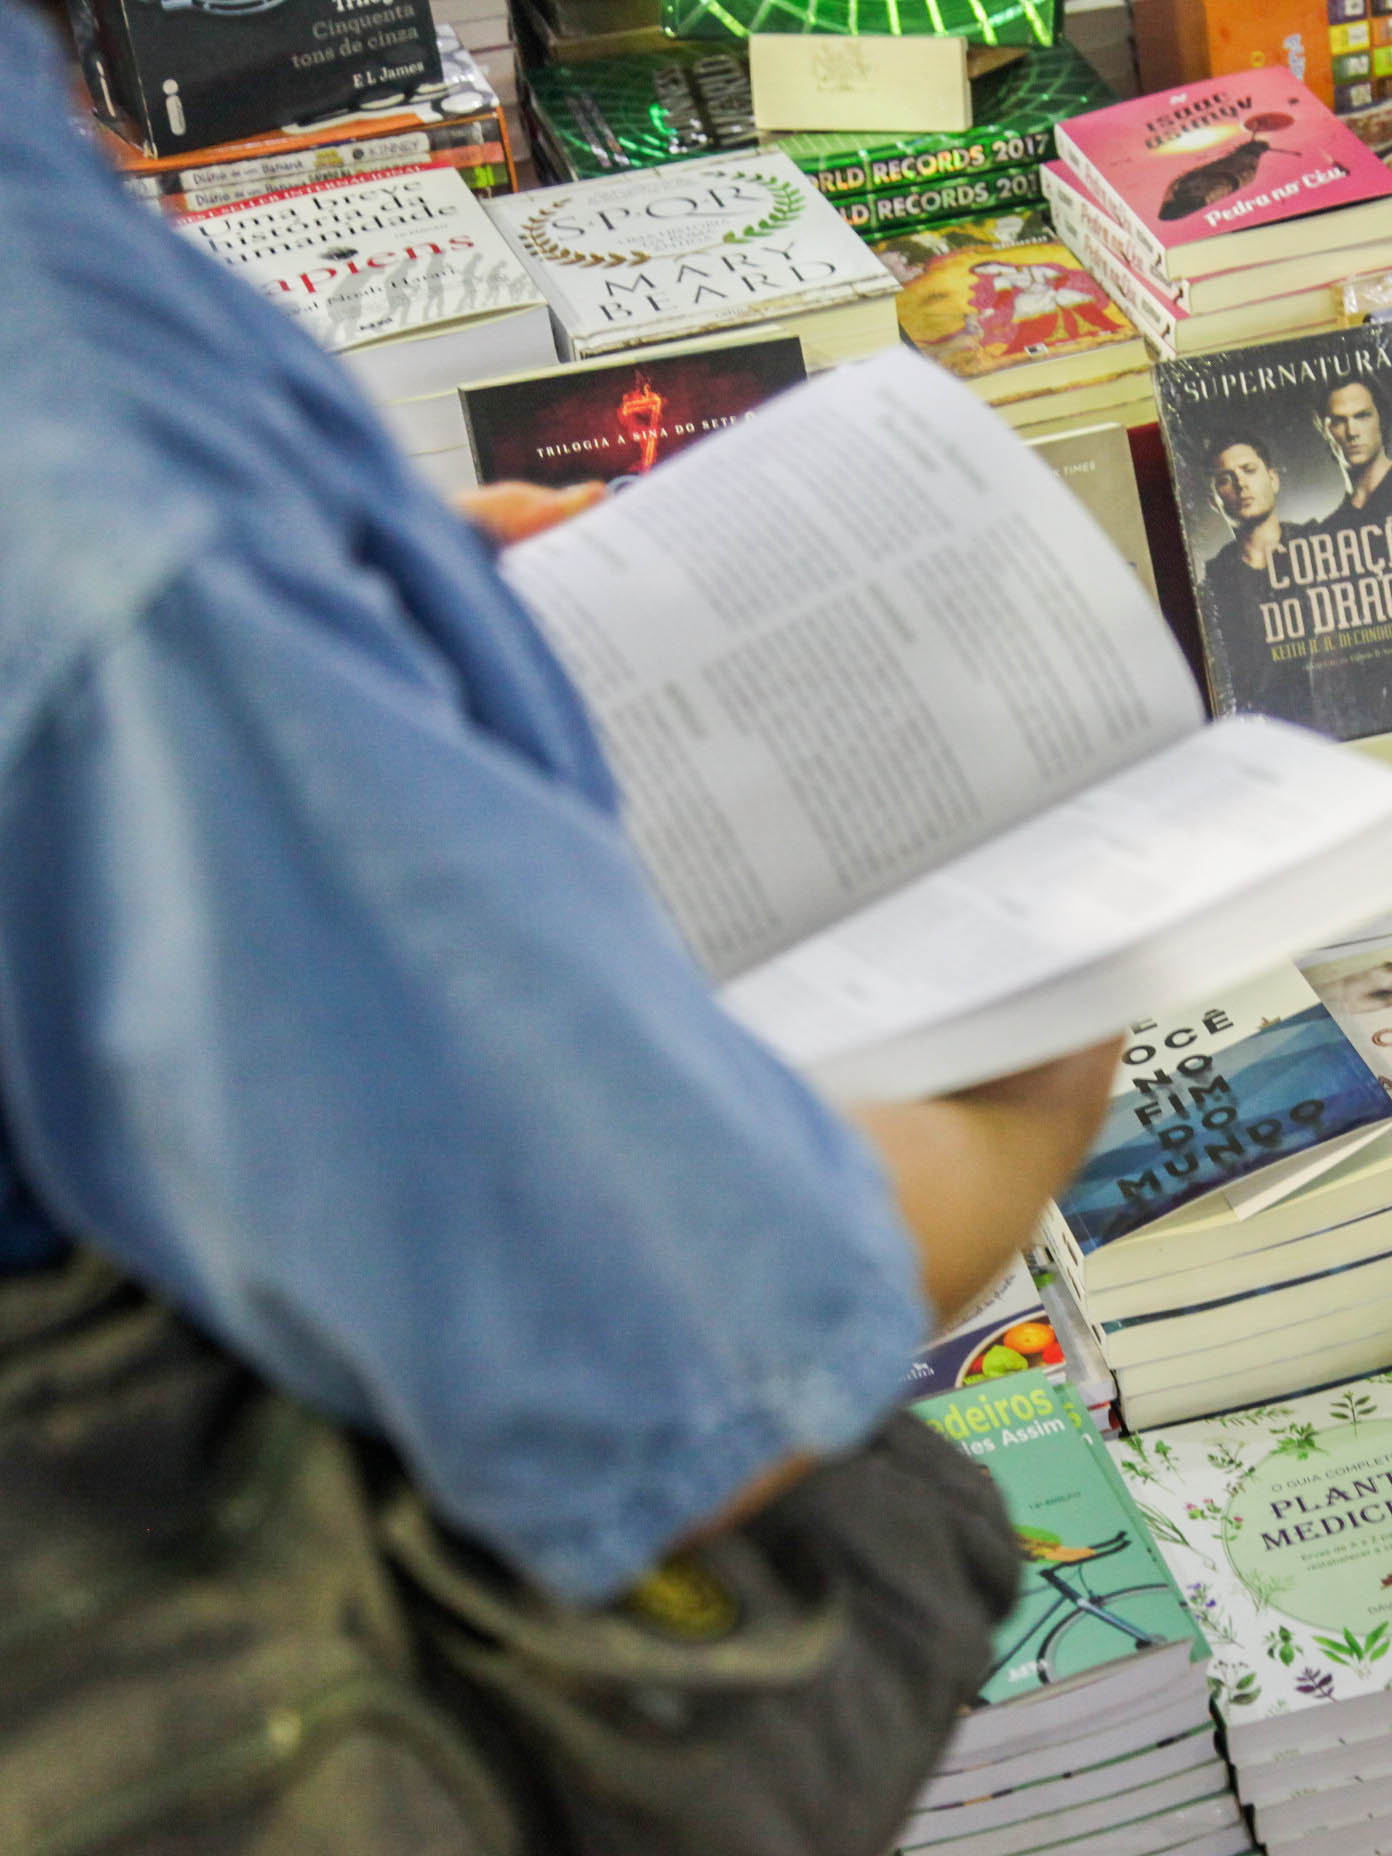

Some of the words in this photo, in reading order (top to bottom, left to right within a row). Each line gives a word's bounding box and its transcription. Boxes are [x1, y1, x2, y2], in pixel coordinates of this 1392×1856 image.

[812, 165, 866, 194] RLD
[872, 144, 986, 185] RECORDS
[992, 132, 1050, 163] 2017
[201, 207, 297, 237] Uma
[312, 180, 423, 210] breve
[207, 209, 363, 252] história
[380, 194, 427, 210] da
[877, 180, 989, 220] RECORDS
[1204, 192, 1270, 229] Pedra
[224, 198, 457, 266] umanidade
[261, 234, 475, 296] apiens
[598, 260, 838, 322] BEARD
[605, 242, 796, 298] MARY
[537, 436, 611, 460] TRILOGIA
[617, 432, 627, 445] A
[632, 426, 669, 442] SINA
[675, 421, 696, 436] DO
[1259, 597, 1305, 644] DO
[1121, 1008, 1235, 1066] OCÊ
[1131, 1053, 1214, 1096] NO
[1133, 1075, 1232, 1129] FIM
[1157, 1105, 1238, 1150] DO
[1116, 1099, 1326, 1203] MUNDO
[927, 1387, 1054, 1441] deiros
[1001, 1416, 1066, 1447] Assim
[1271, 1483, 1283, 1493] O
[1286, 1473, 1323, 1490] GUIA
